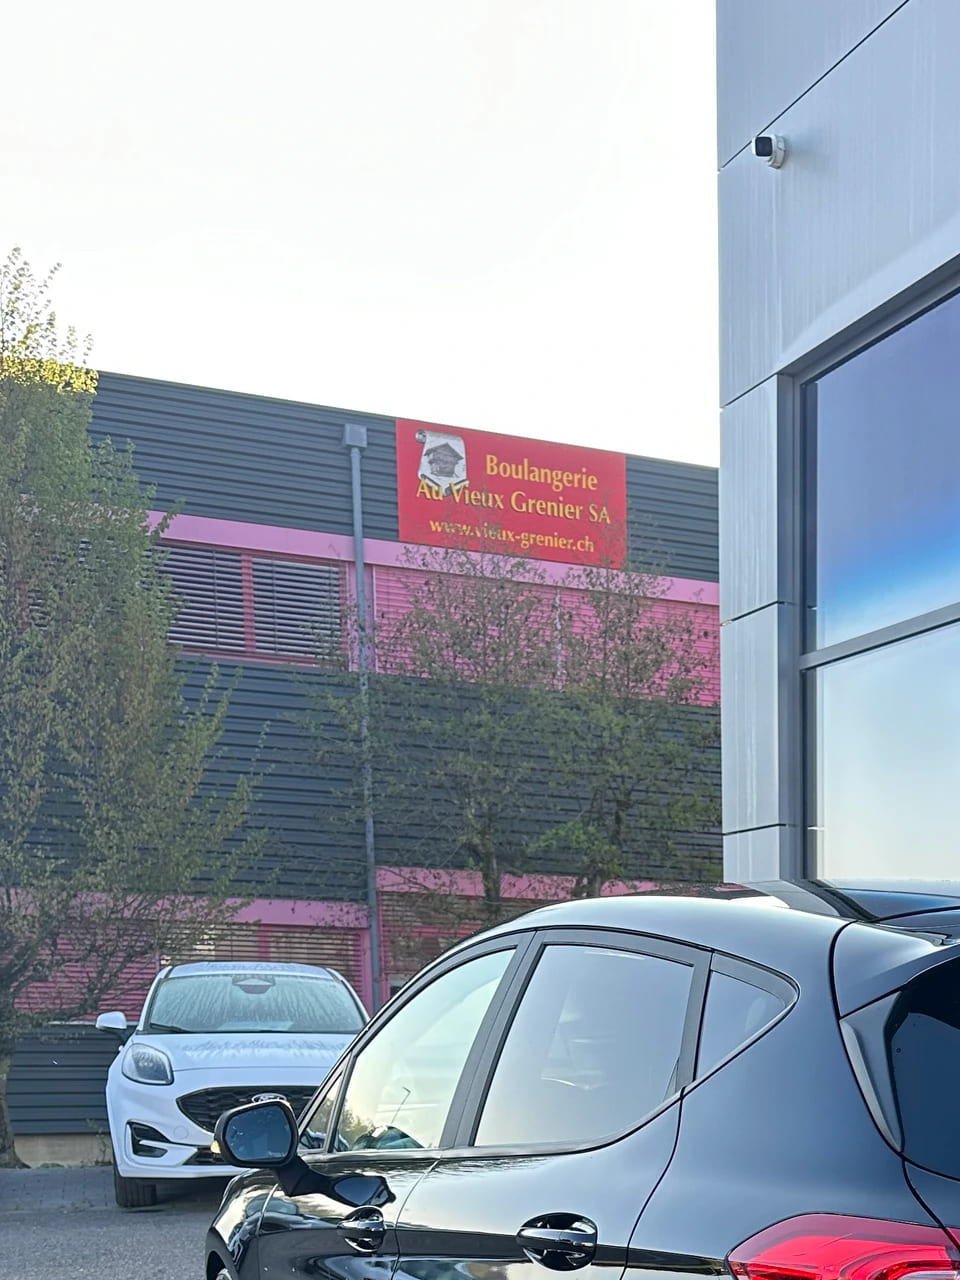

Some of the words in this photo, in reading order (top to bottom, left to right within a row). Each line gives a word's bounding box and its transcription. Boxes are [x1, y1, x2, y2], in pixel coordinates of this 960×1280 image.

[486, 454, 598, 491] Boulangerie
[416, 475, 444, 501] Au
[451, 481, 504, 510] Vieux
[511, 492, 583, 521] Grenier
[589, 504, 611, 525] SA
[430, 520, 594, 553] www.vieux-grenier.ch
